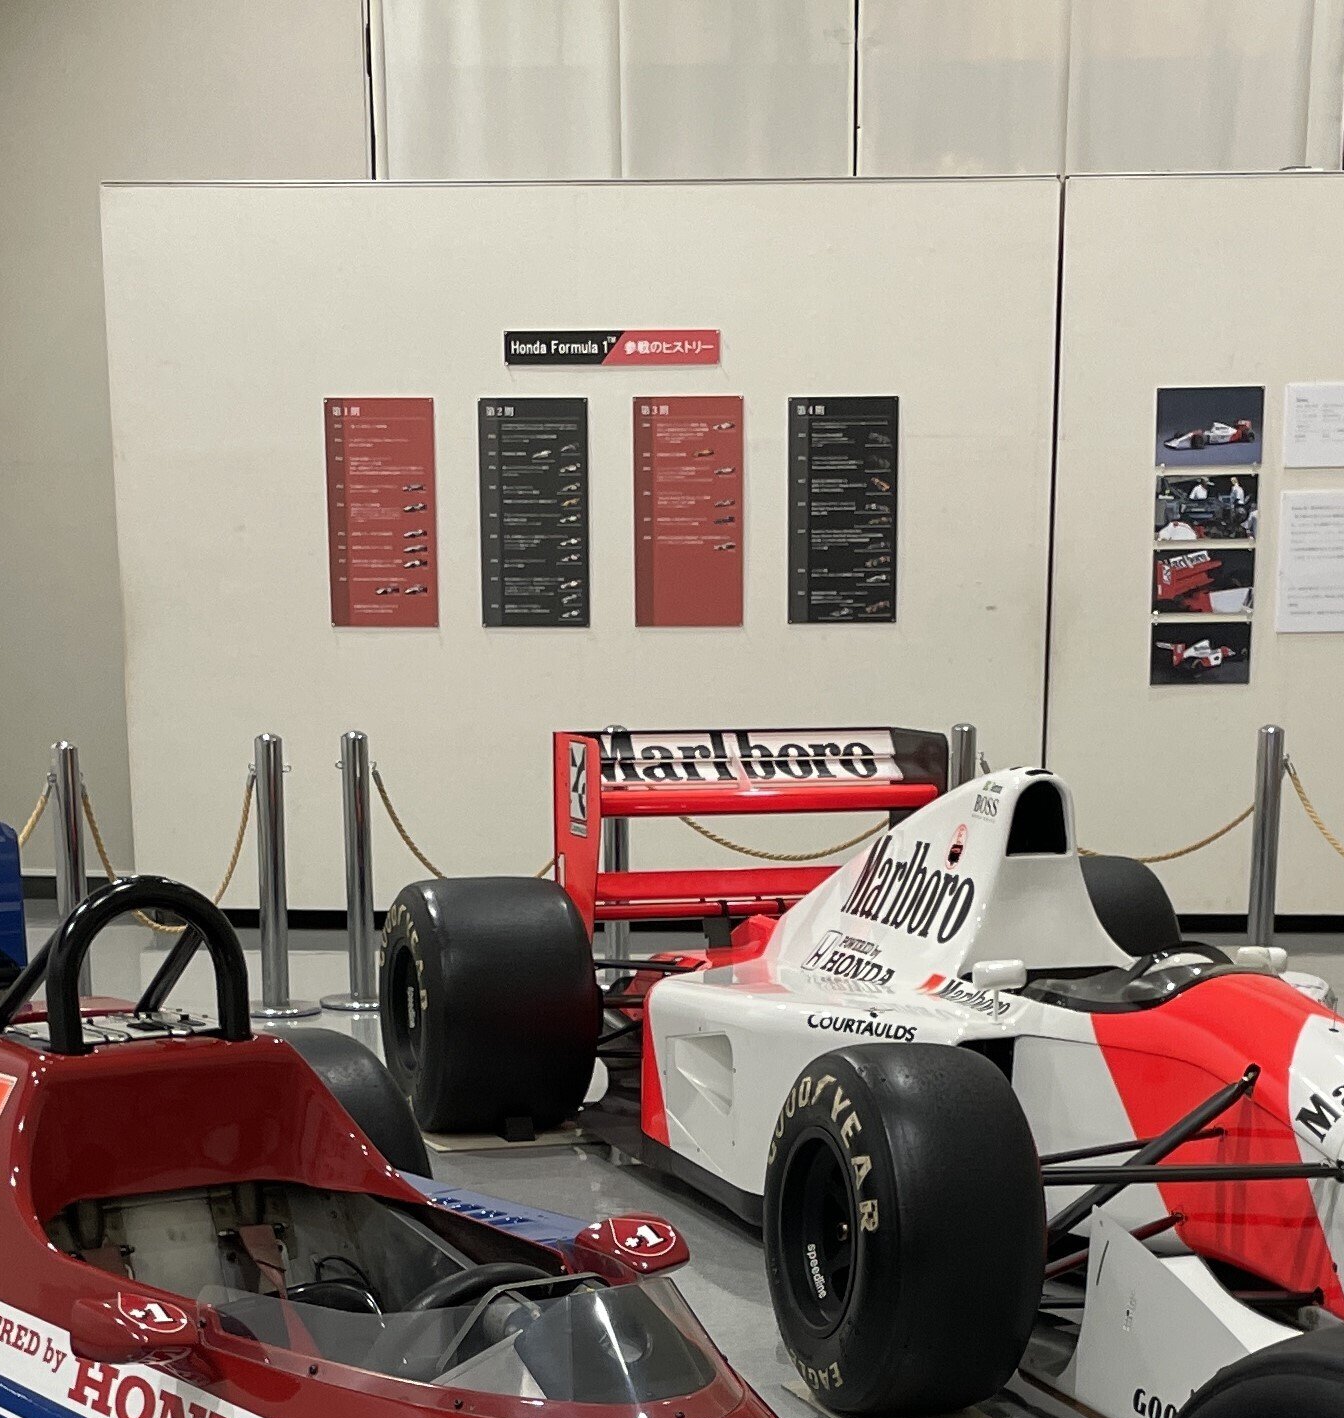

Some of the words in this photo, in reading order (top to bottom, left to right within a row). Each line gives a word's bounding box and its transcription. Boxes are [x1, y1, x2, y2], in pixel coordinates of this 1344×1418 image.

[510, 340, 547, 355] Honda
[550, 340, 599, 355] Formula
[624, 340, 714, 356] 参戦のヒストリー
[600, 730, 878, 782] Marlboro
[973, 794, 1000, 817] BOSS
[840, 835, 975, 944] Marlboro
[820, 951, 895, 985] HONDA
[807, 1013, 917, 1042] COURTAULDS
[807, 1243, 828, 1299] speedline
[42, 1336, 68, 1374] by
